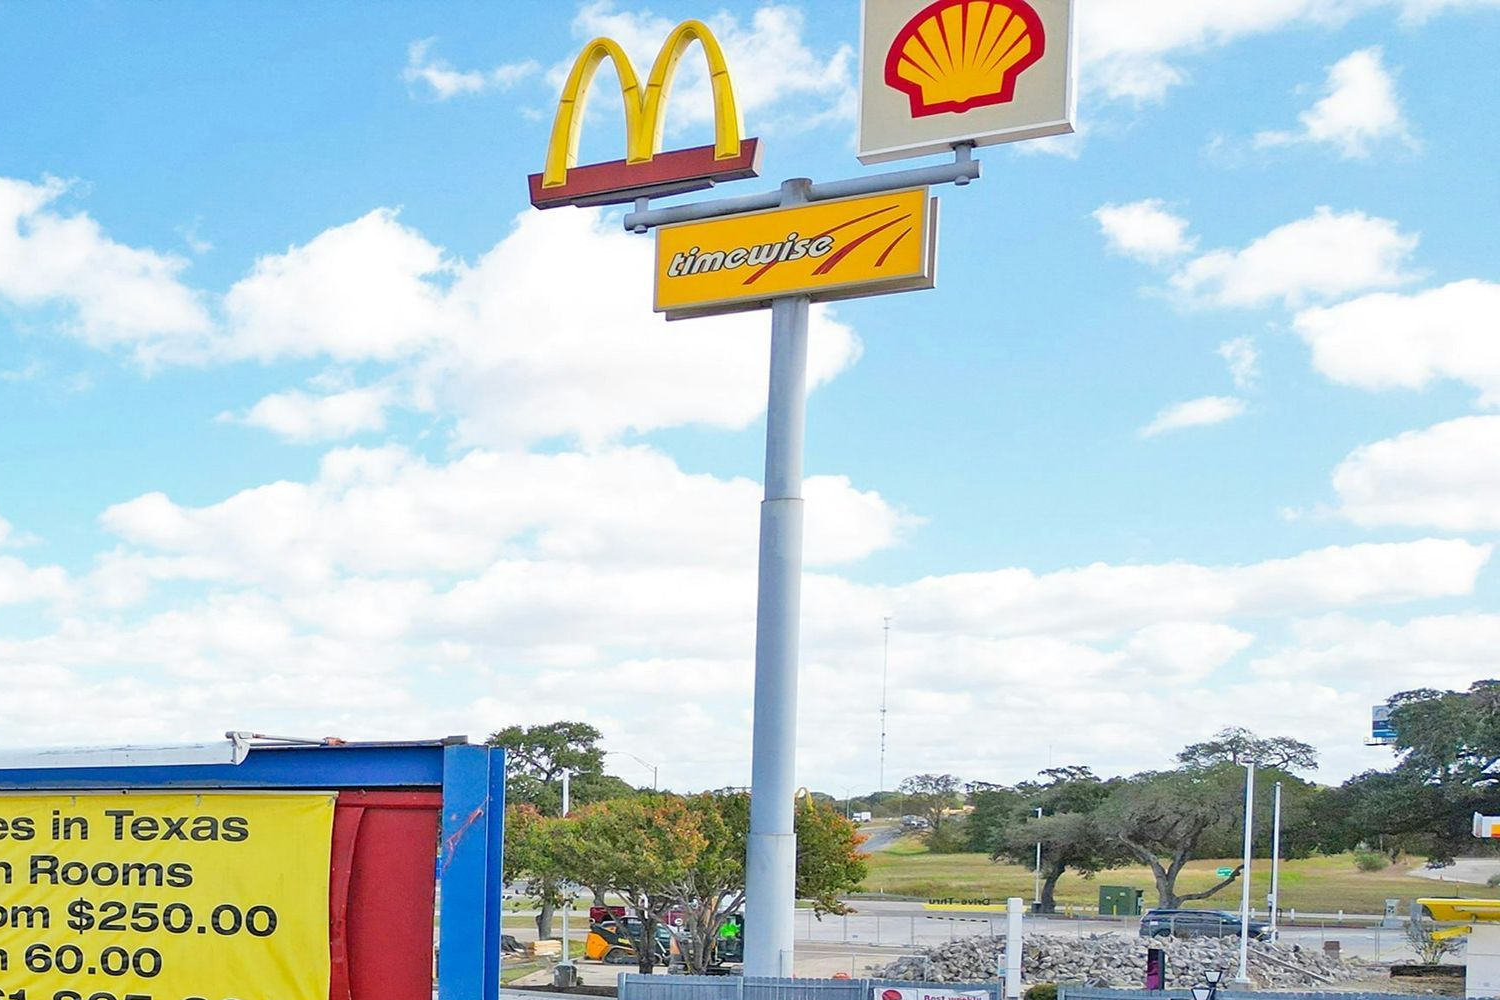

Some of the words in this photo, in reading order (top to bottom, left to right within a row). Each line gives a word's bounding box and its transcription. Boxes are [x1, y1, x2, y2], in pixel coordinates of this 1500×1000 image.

[666, 231, 835, 279] timewise
[51, 810, 90, 841] in
[104, 810, 249, 842] Texas
[29, 855, 193, 888] Rooms
[67, 897, 278, 937] $250.00
[24, 943, 162, 978] 60.00
